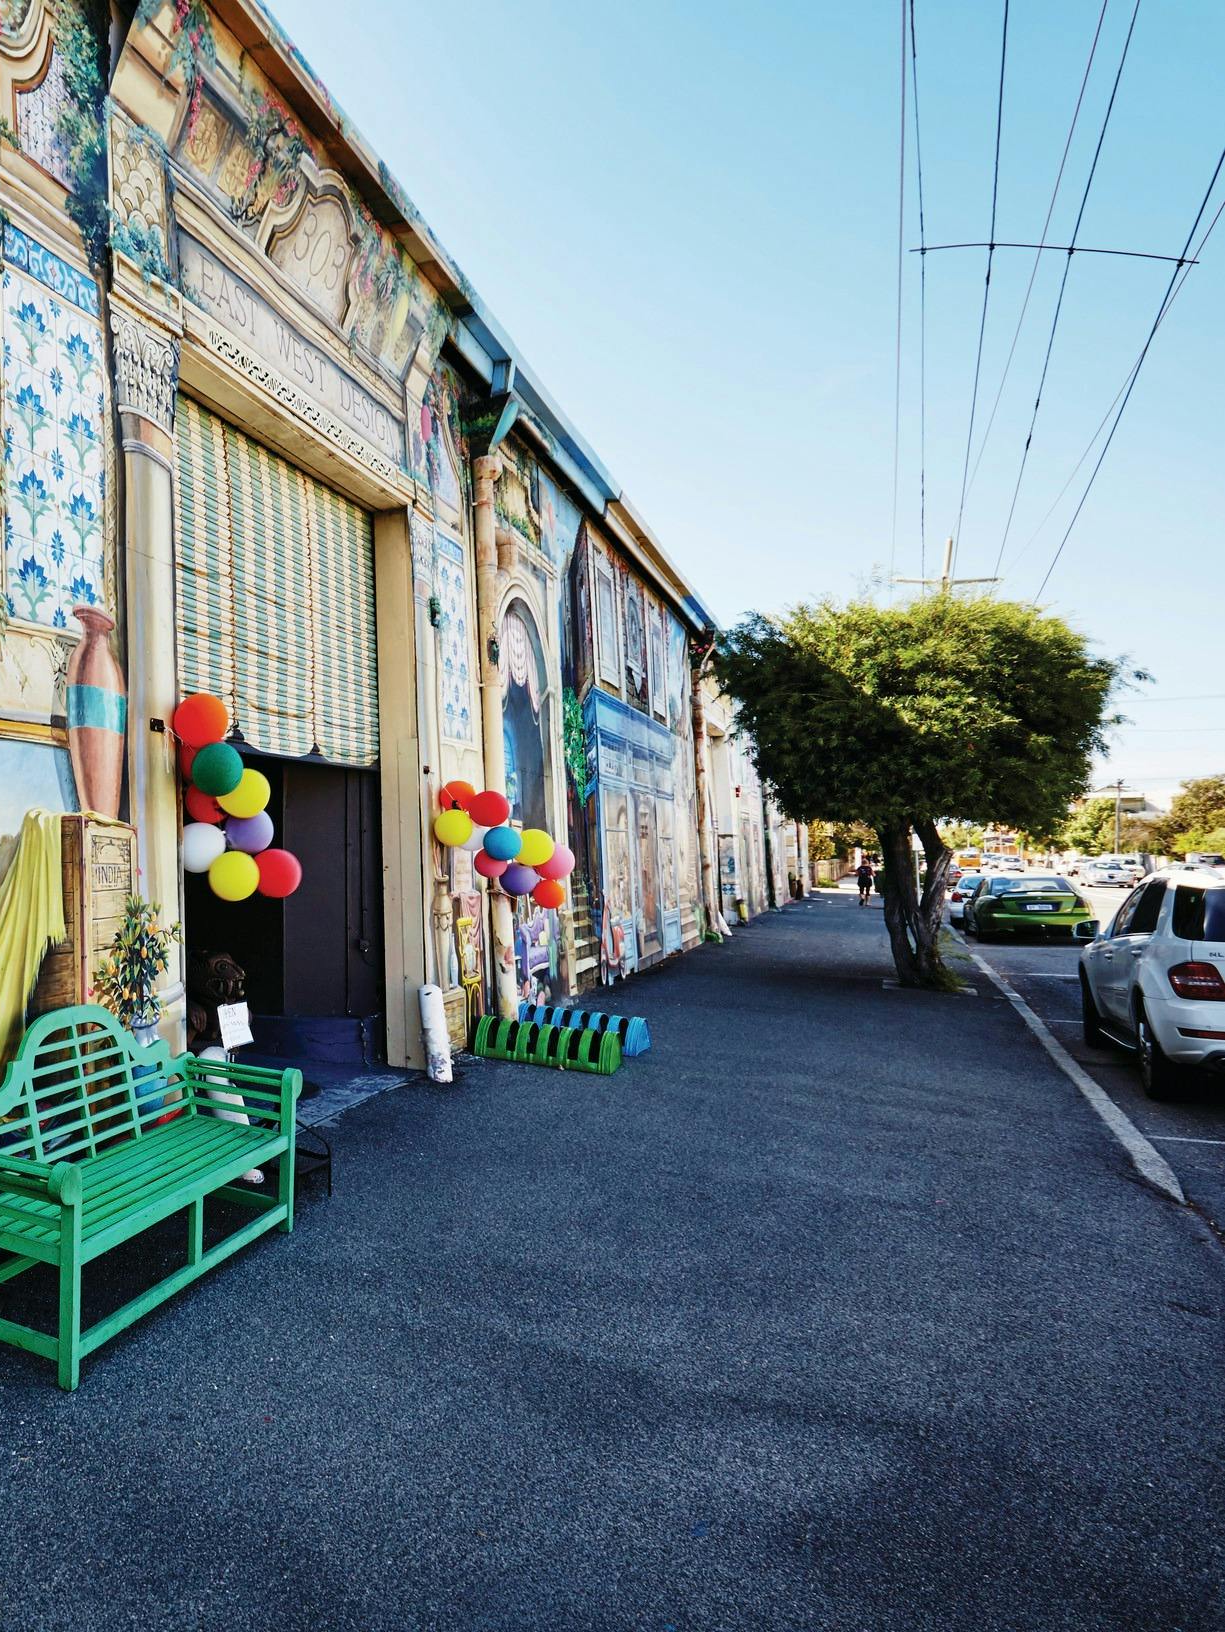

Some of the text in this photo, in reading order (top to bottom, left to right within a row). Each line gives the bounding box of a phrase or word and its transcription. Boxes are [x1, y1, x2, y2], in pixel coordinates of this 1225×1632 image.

[293, 212, 346, 291] 303
[198, 251, 396, 450] EAST WEST DESIGN
